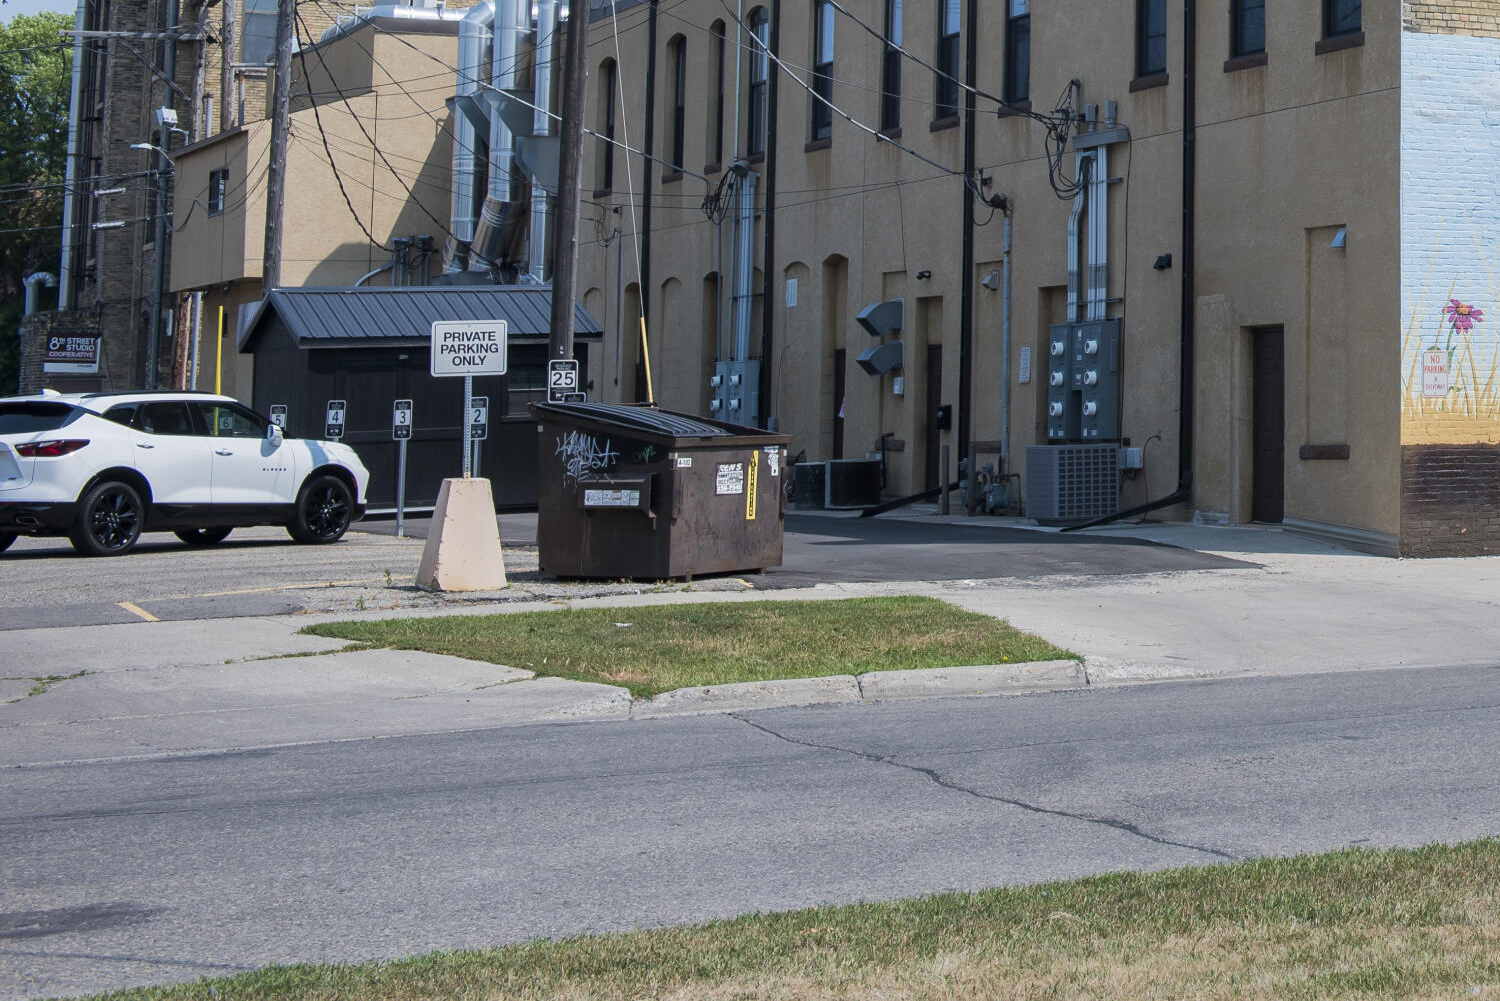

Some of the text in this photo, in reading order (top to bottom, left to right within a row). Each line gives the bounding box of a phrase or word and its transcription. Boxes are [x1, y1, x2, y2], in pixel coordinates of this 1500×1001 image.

[66, 337, 95, 345] STREET
[443, 331, 497, 343] PRIVATE
[440, 343, 499, 355] PARKING
[452, 355, 487, 366] ONLY
[1430, 354, 1441, 364] NO
[1424, 365, 1447, 374] PARKING
[552, 372, 574, 386] 25
[275, 415, 282, 426] 5
[331, 411, 339, 423] 4
[399, 411, 407, 424] 3
[474, 408, 482, 423] 2
[223, 418, 230, 428] 6
